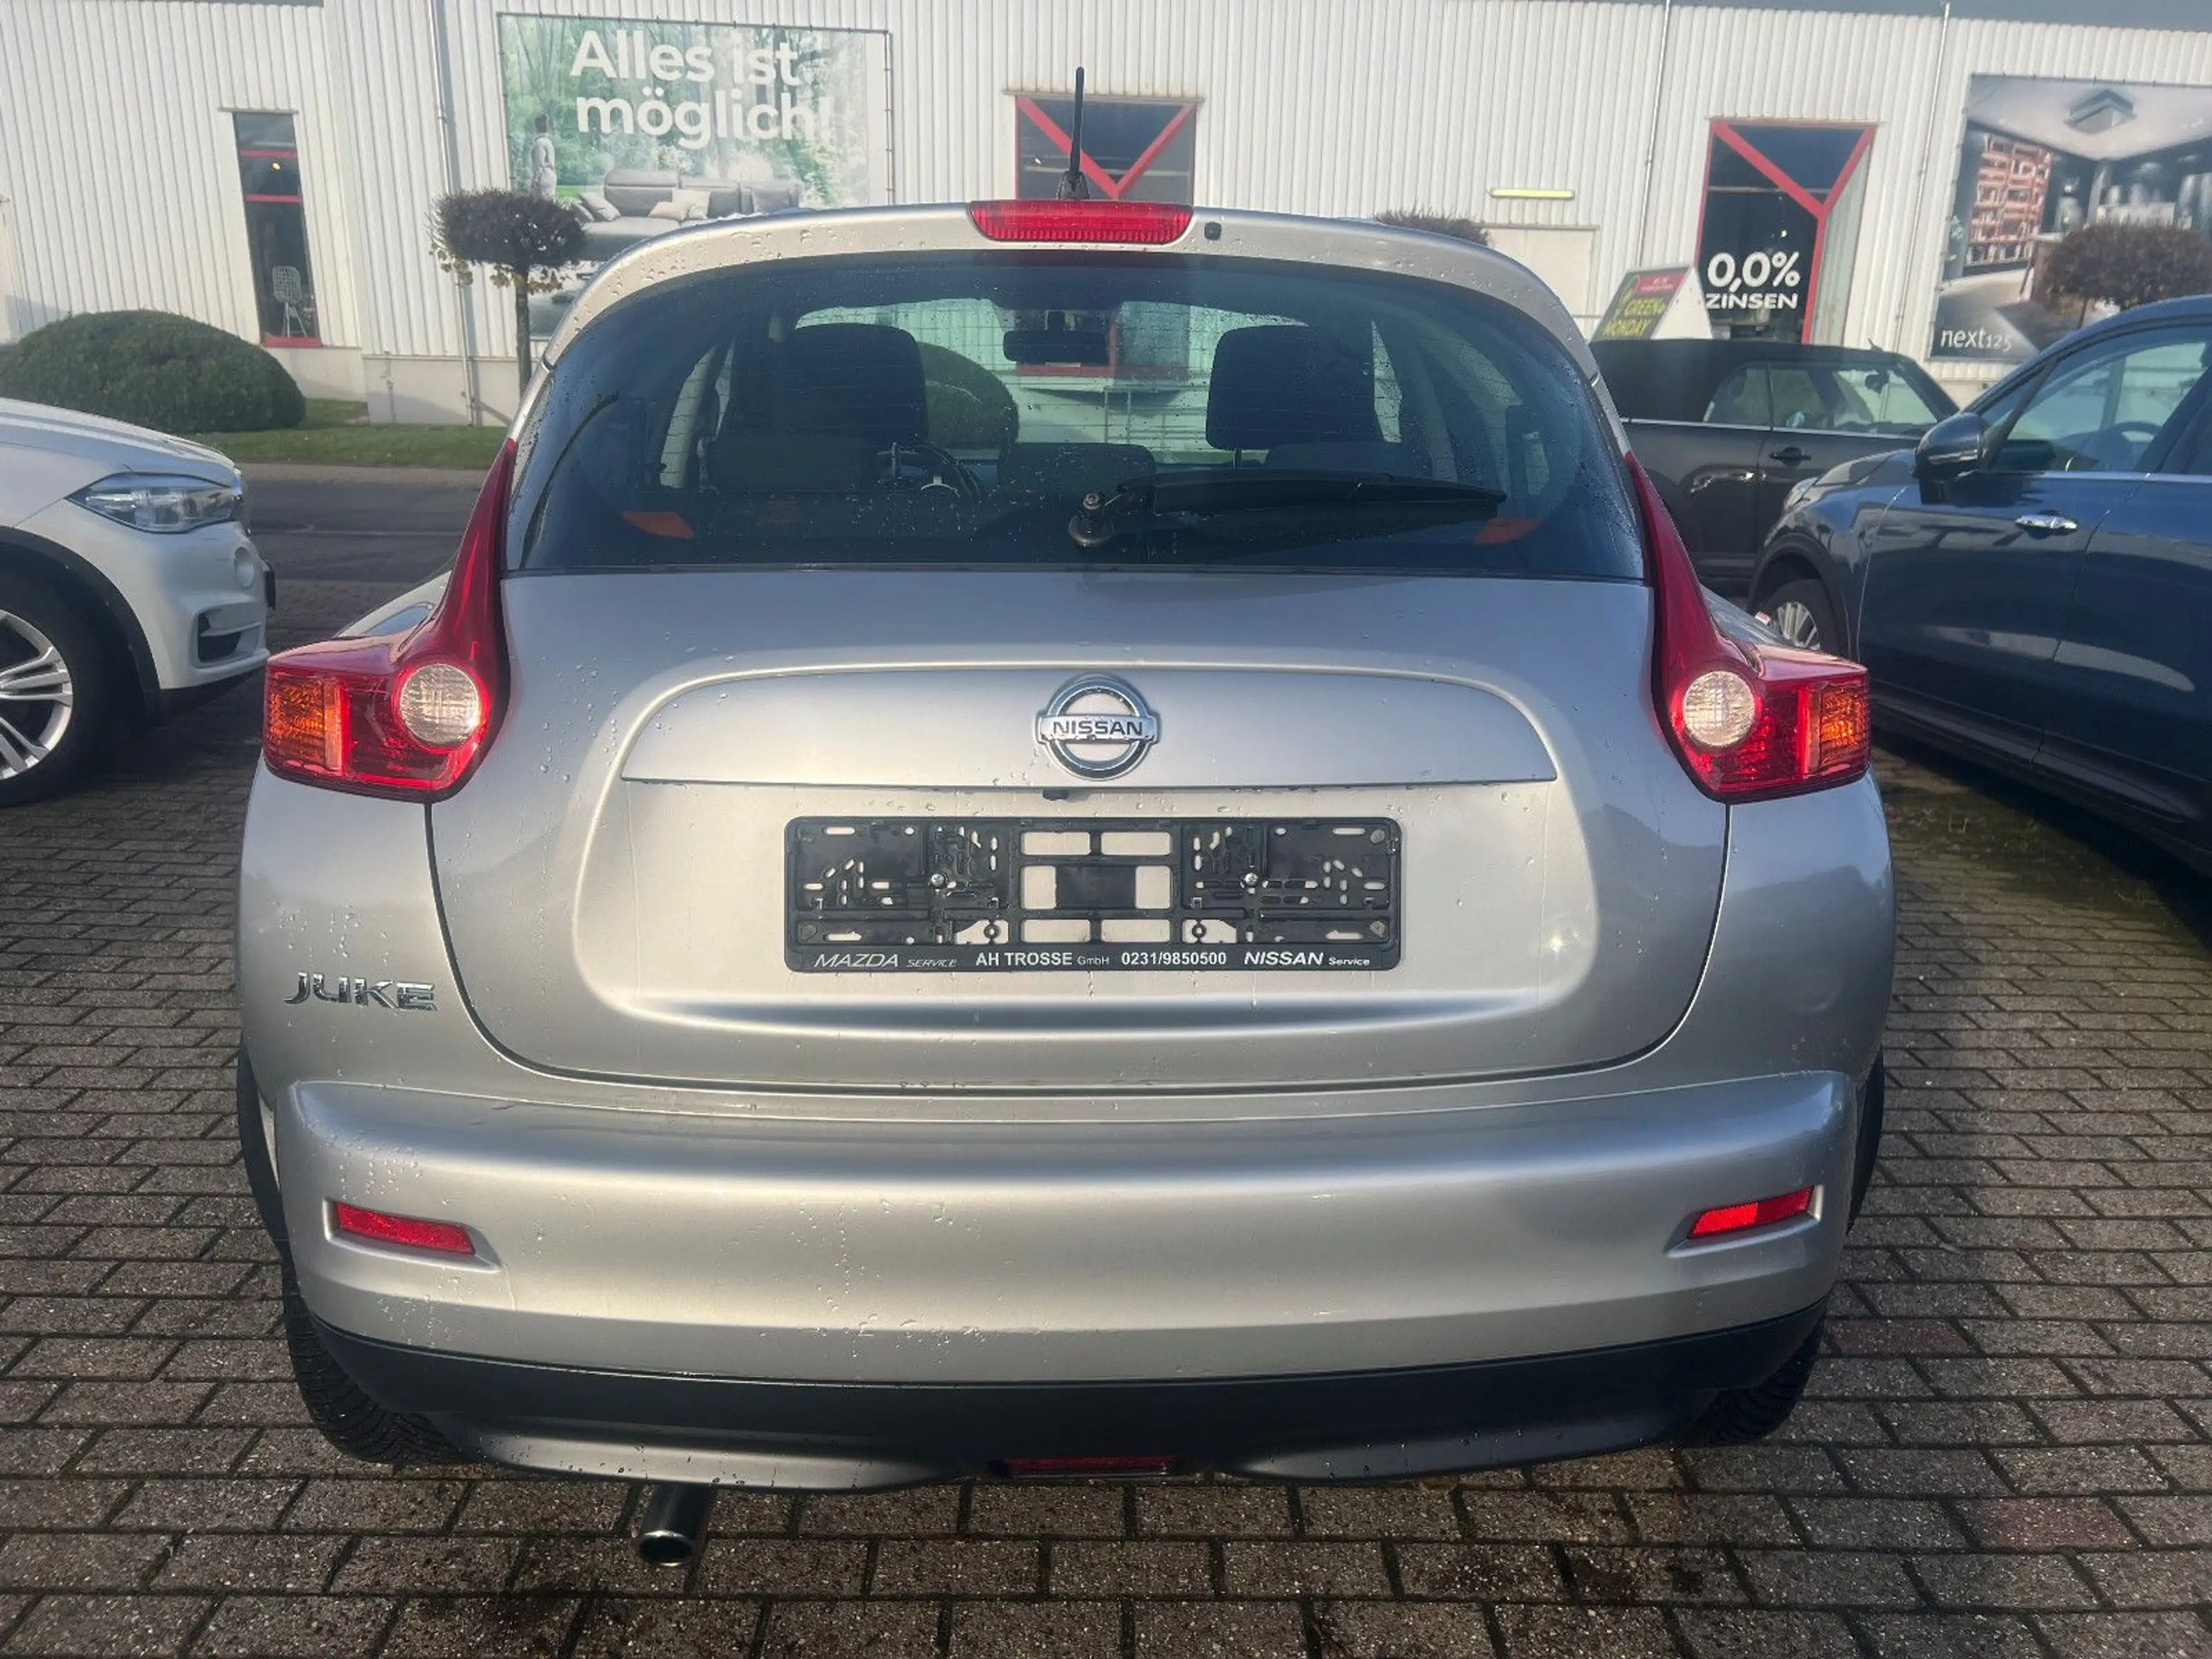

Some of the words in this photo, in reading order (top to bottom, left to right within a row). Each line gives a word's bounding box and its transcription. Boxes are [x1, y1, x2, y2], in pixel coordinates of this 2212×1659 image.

[570, 30, 714, 82] Alles
[733, 35, 802, 86] ist
[576, 88, 831, 149] möglich!
[1707, 252, 1800, 292] 0,0%
[1705, 293, 1797, 309] ZINSEN
[1053, 721, 1142, 735] NISSAN
[815, 953, 899, 967] MAZDA
[906, 959, 957, 967] SERVICE
[976, 953, 999, 965] AH
[1004, 953, 1072, 965] TROSSE
[1077, 957, 1110, 965] GmbH
[1122, 952, 1227, 965] 0231/9850500
[1244, 952, 1324, 965] NISSAN
[1328, 957, 1370, 965] Service
[283, 971, 438, 1011] JUKE
